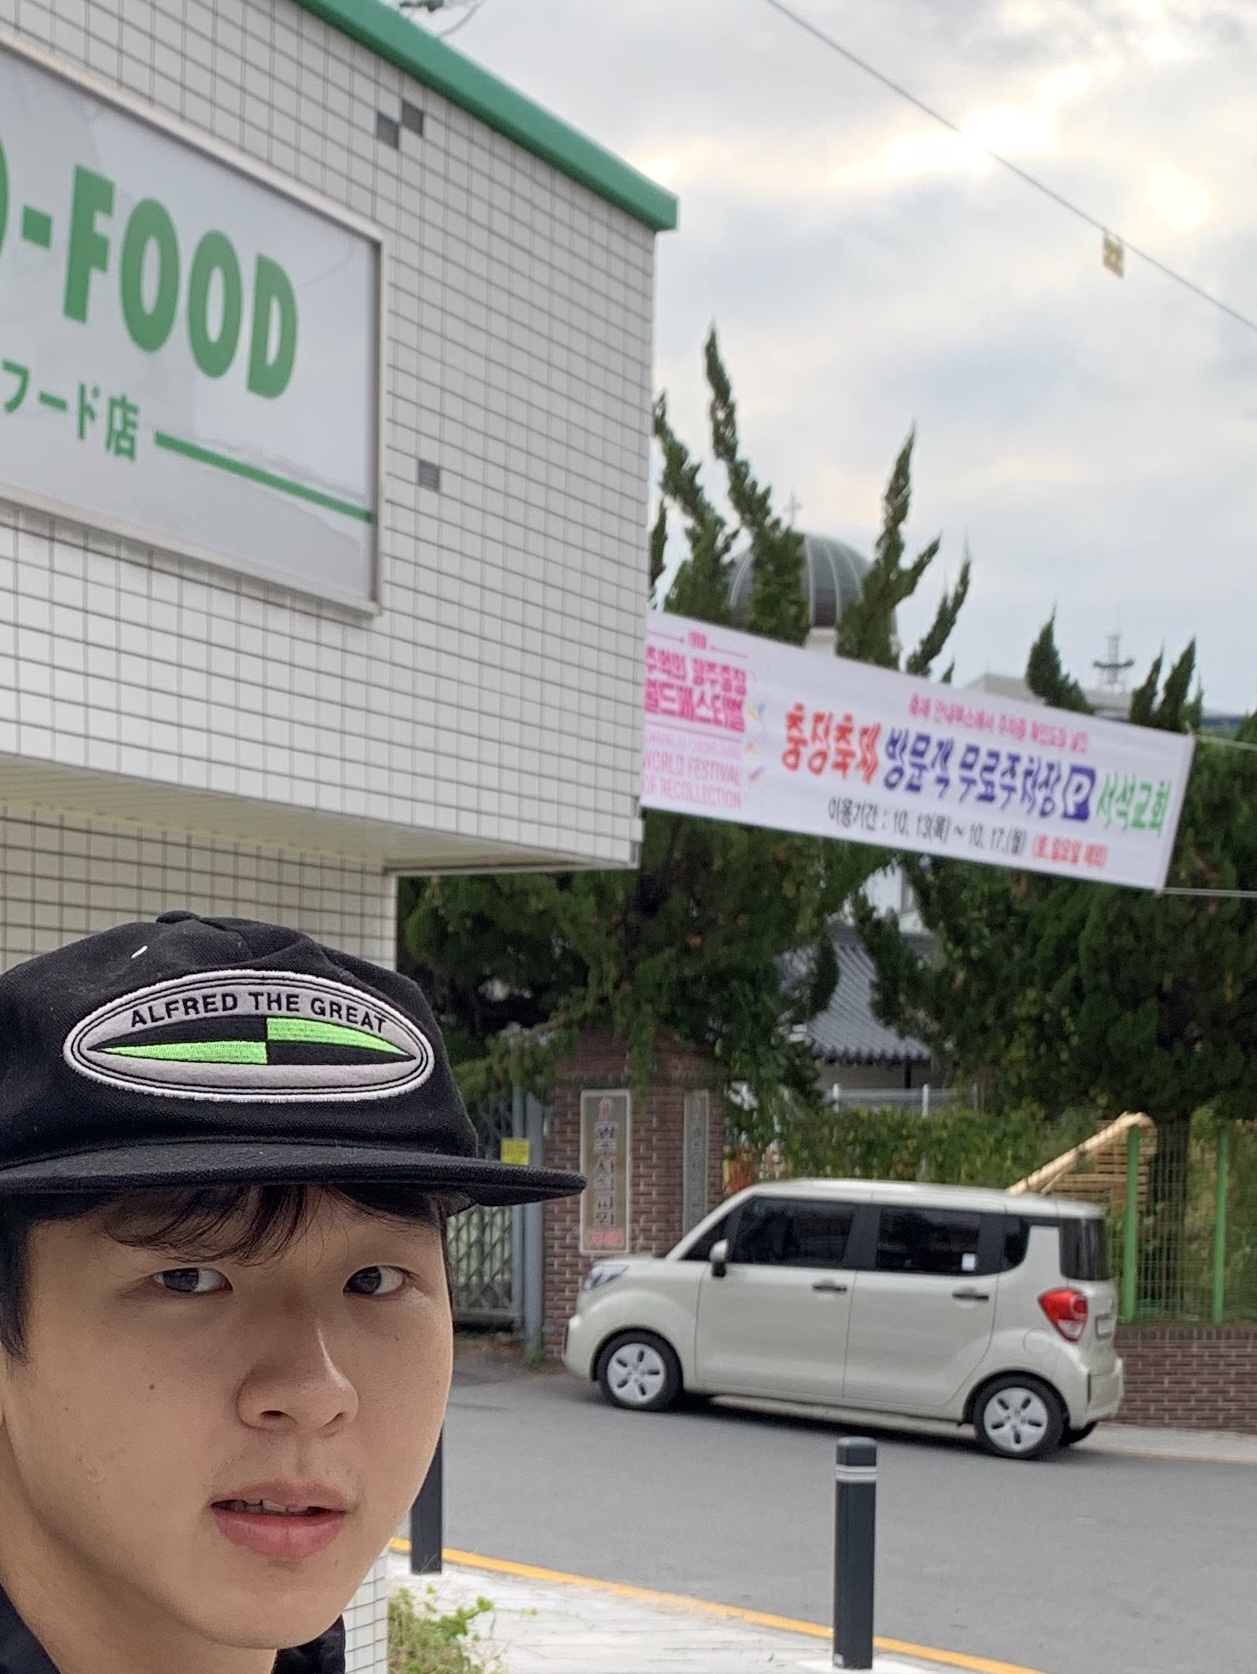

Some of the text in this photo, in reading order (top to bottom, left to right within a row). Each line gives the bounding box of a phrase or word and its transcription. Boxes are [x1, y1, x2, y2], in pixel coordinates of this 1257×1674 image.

[884, 728, 954, 799] 방문객
[959, 743, 1061, 819] 무료주차장
[828, 797, 878, 831] 이용기간
[1096, 769, 1172, 838] 서석교회
[130, 991, 387, 1035] ALFRED THE GREAT
